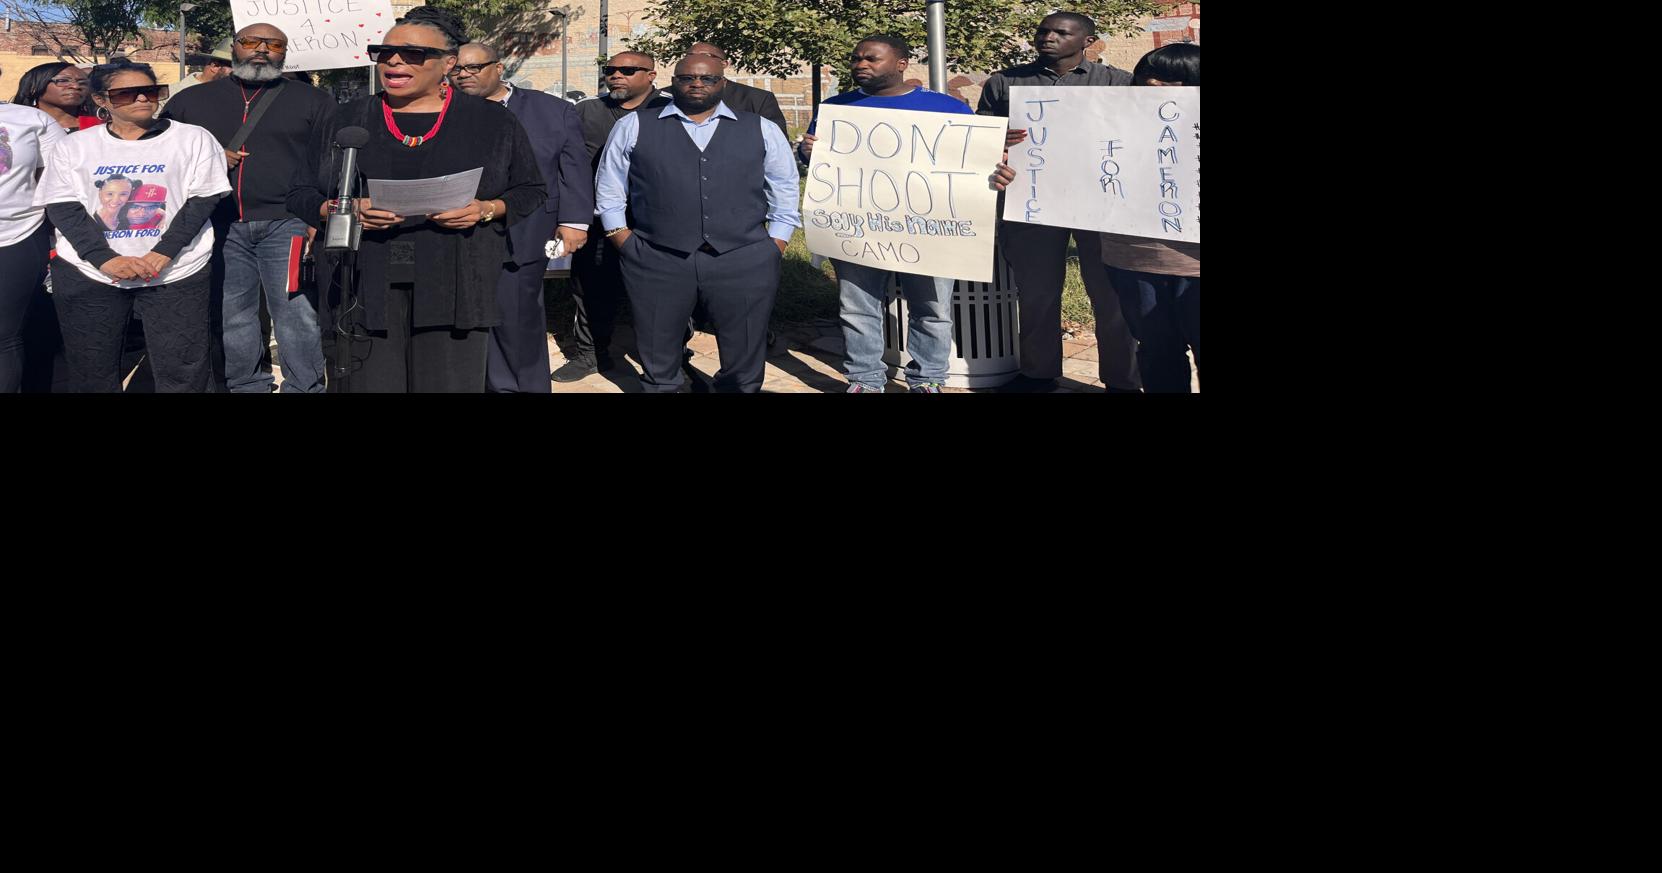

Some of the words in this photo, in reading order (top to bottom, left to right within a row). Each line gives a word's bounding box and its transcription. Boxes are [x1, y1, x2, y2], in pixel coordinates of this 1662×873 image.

[287, 30, 359, 54] ERON
[829, 119, 1001, 169] DON'T
[1025, 99, 1060, 223] JUSTICE
[93, 164, 140, 176] JUSTICE
[141, 164, 166, 174] FOR
[1097, 139, 1125, 199] FOR
[1158, 100, 1183, 233] CAMERON
[807, 162, 979, 219] SHOOT
[135, 228, 161, 238] FORD
[811, 208, 865, 239] Say
[841, 239, 921, 264] CAMO
